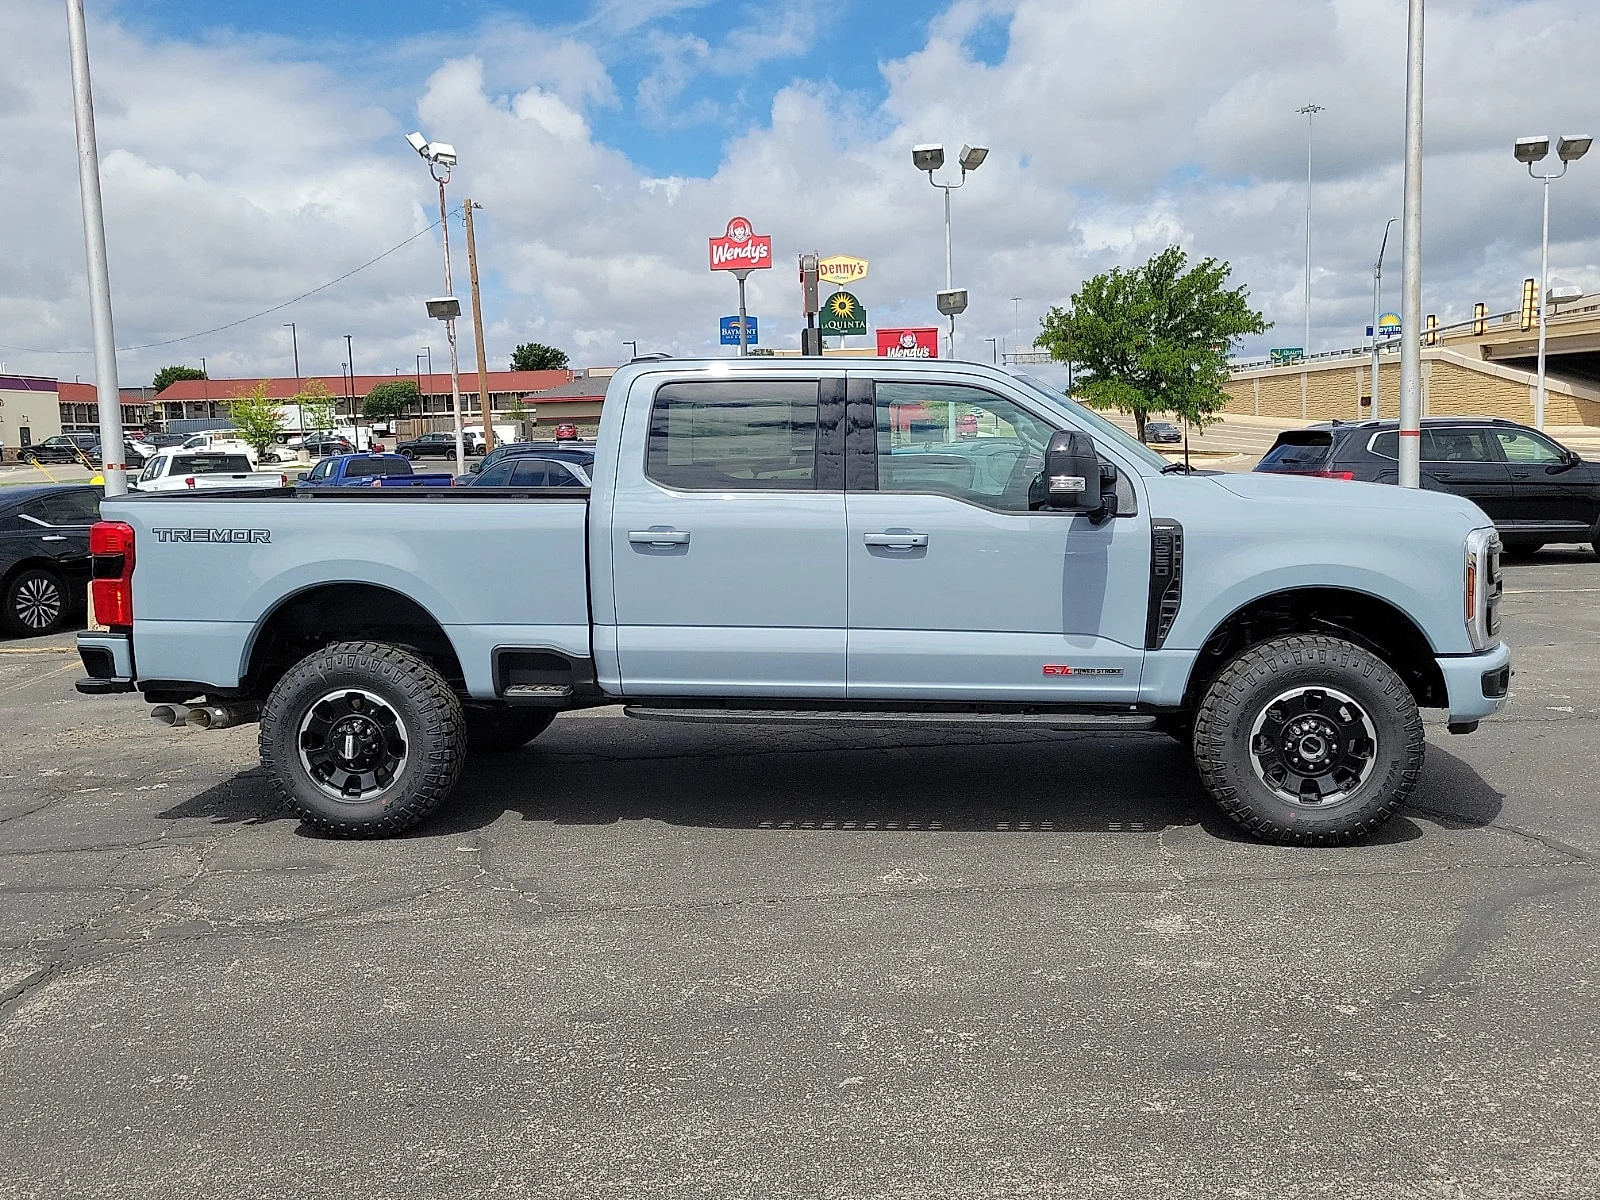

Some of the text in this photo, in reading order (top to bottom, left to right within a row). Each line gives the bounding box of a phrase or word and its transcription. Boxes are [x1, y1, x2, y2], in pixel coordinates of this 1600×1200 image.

[713, 239, 768, 265] Wendy's
[819, 262, 865, 276] Denny's
[722, 328, 756, 336] BAYMNT
[828, 320, 866, 331] QUINTA
[886, 343, 930, 358] Wendy's
[152, 528, 271, 543] TREMOR
